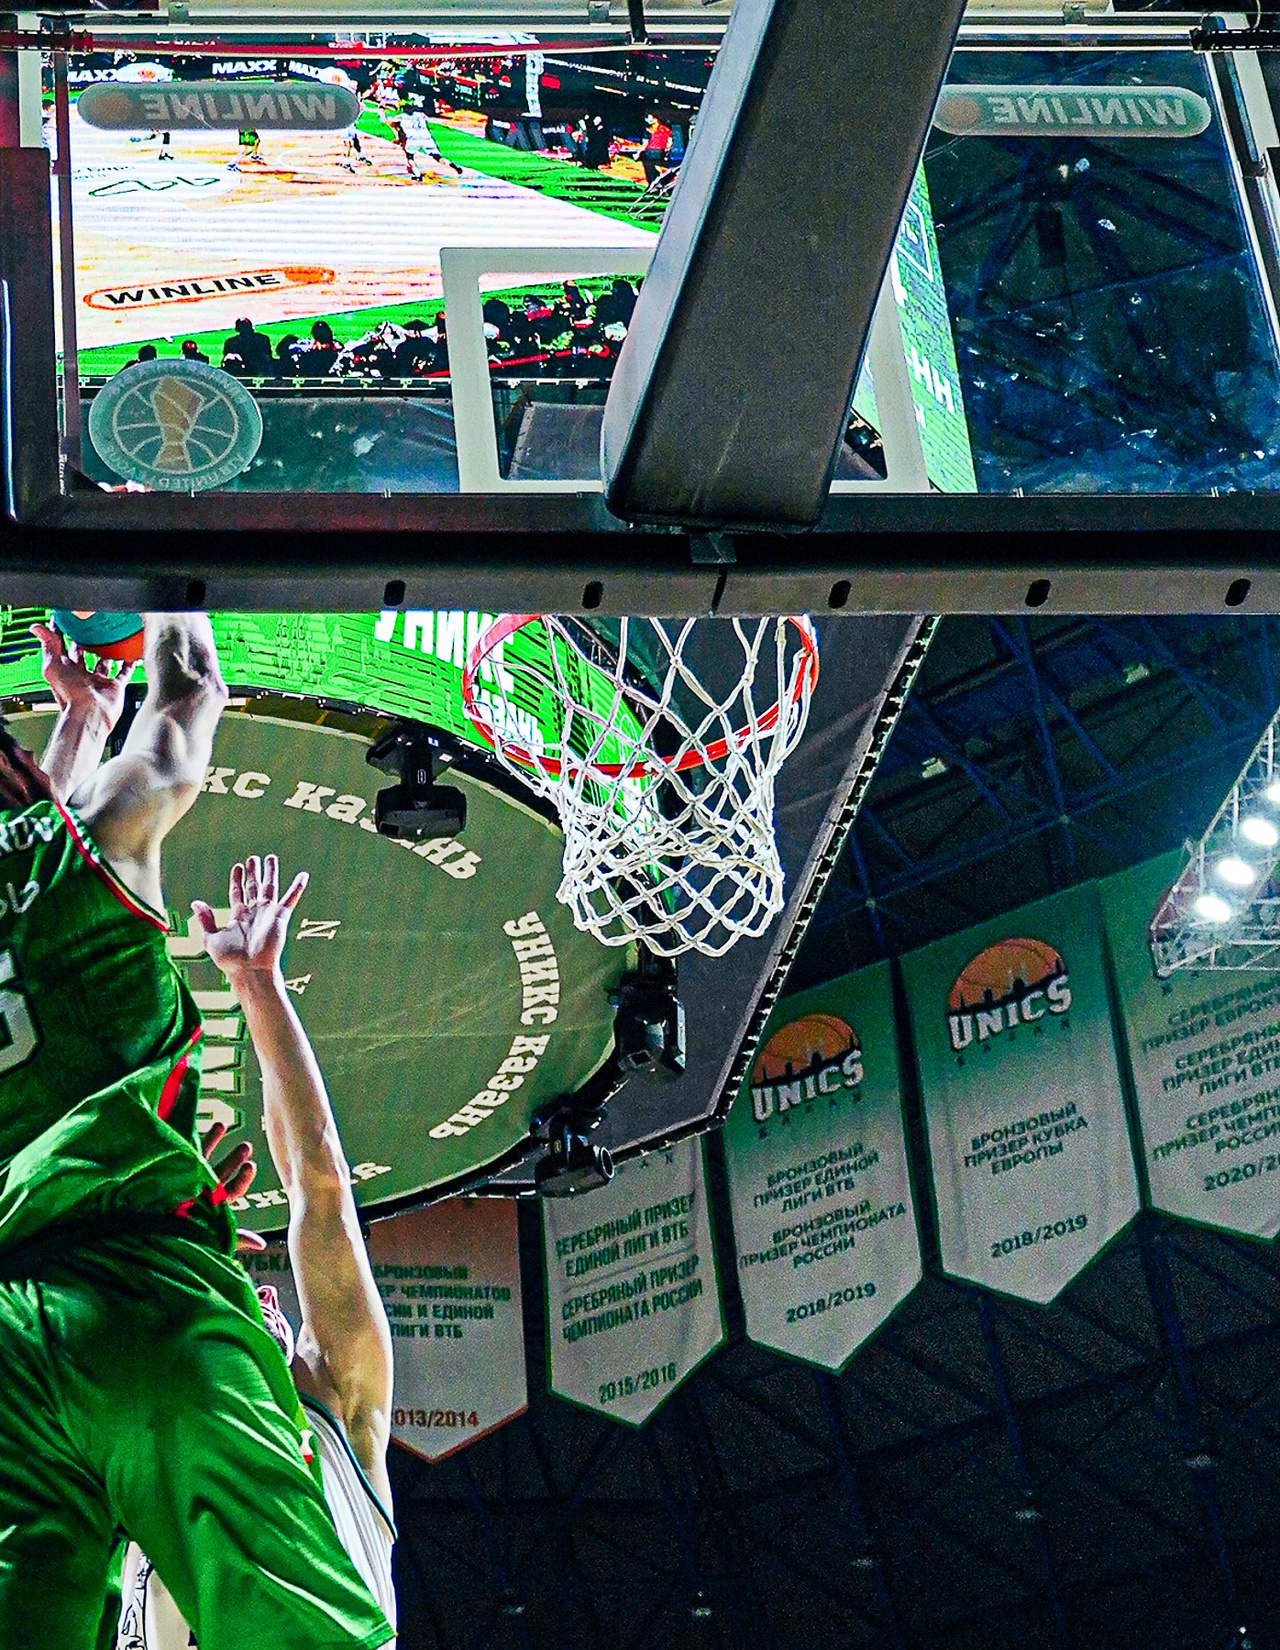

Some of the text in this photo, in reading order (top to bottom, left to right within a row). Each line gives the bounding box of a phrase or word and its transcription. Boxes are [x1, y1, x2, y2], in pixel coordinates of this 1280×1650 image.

[104, 274, 281, 305] WINLINE
[948, 974, 1074, 1054] UNICS
[751, 1048, 866, 1123] UNICS
[990, 1212, 1088, 1259] 2018/2019
[393, 1409, 479, 1428] 013/2014
